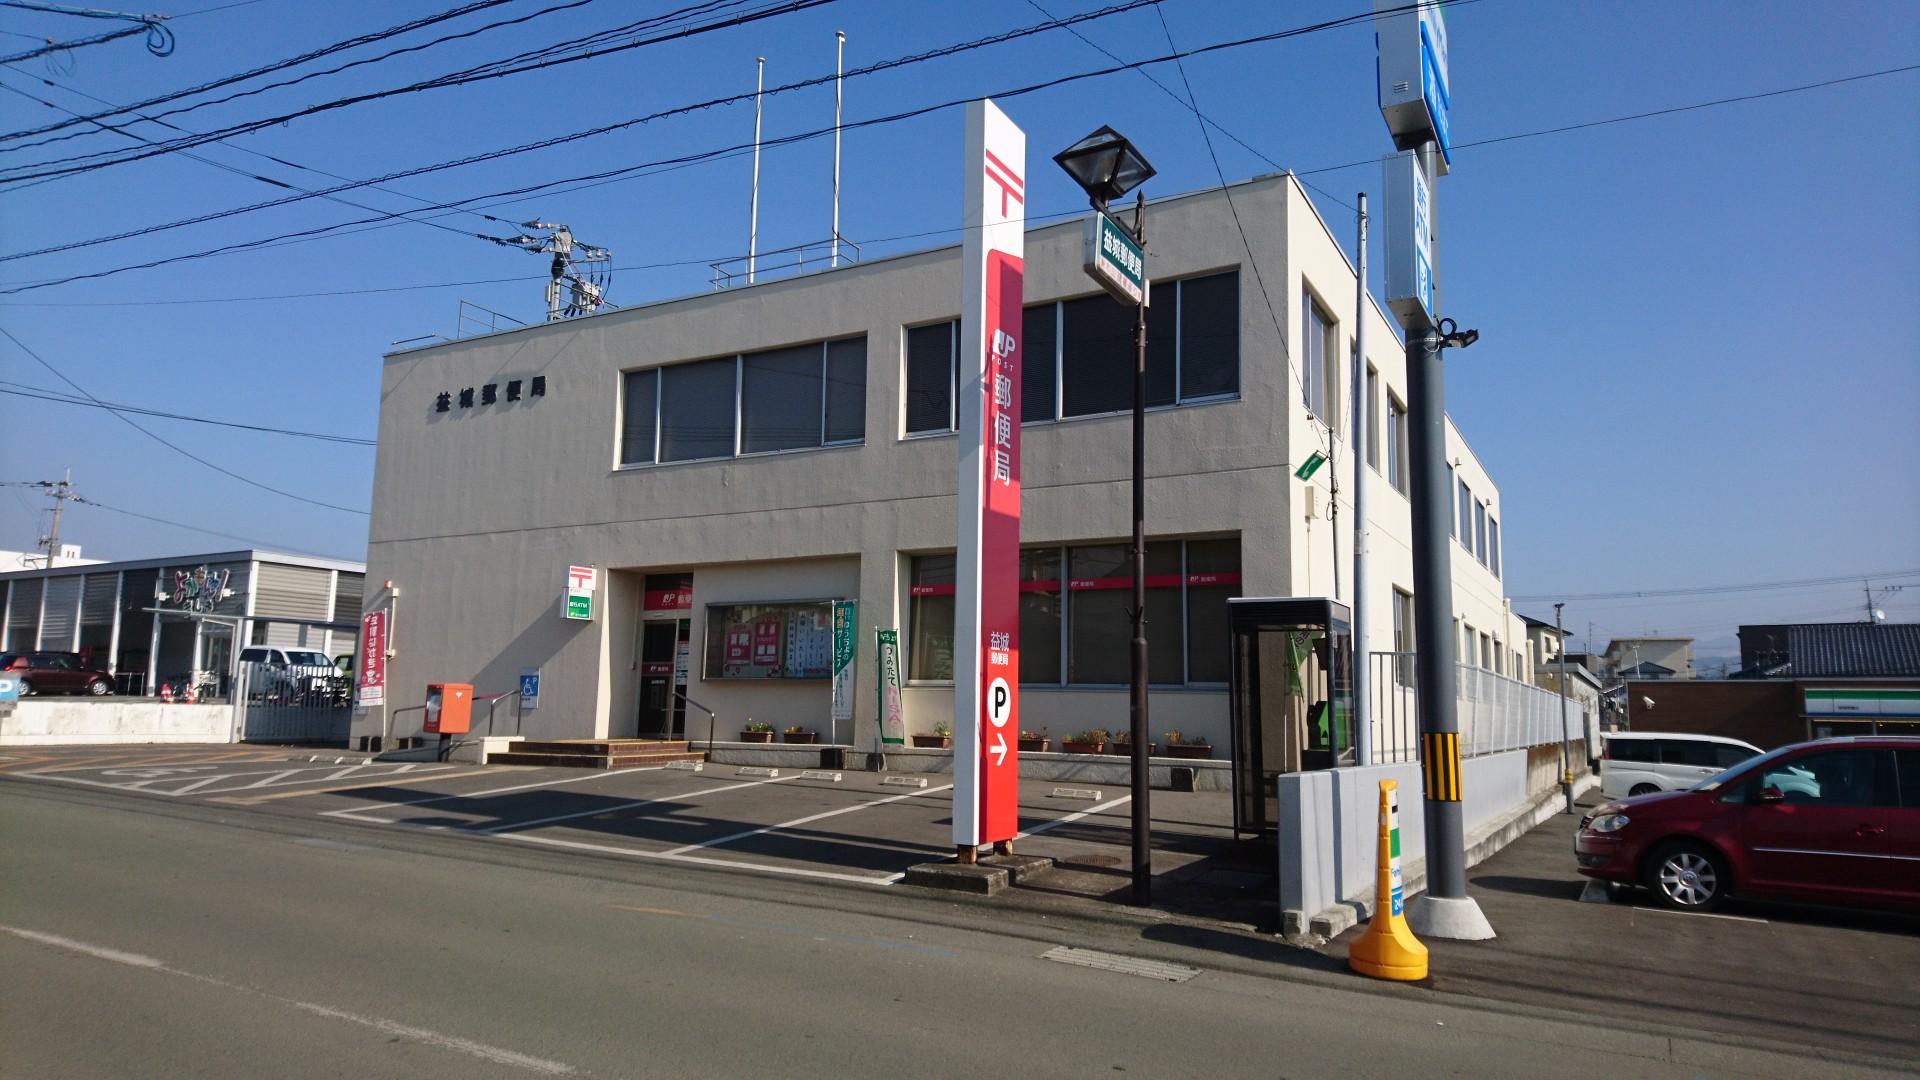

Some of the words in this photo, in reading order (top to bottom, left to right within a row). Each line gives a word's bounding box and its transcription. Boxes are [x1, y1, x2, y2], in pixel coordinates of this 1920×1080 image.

[1103, 228, 1142, 280] 益城郵便局
[992, 354, 1015, 372] POST
[993, 373, 1012, 486] 郵便局
[991, 632, 1009, 652] 益城
[991, 652, 1009, 666] 郵便局
[994, 686, 1007, 719] P
